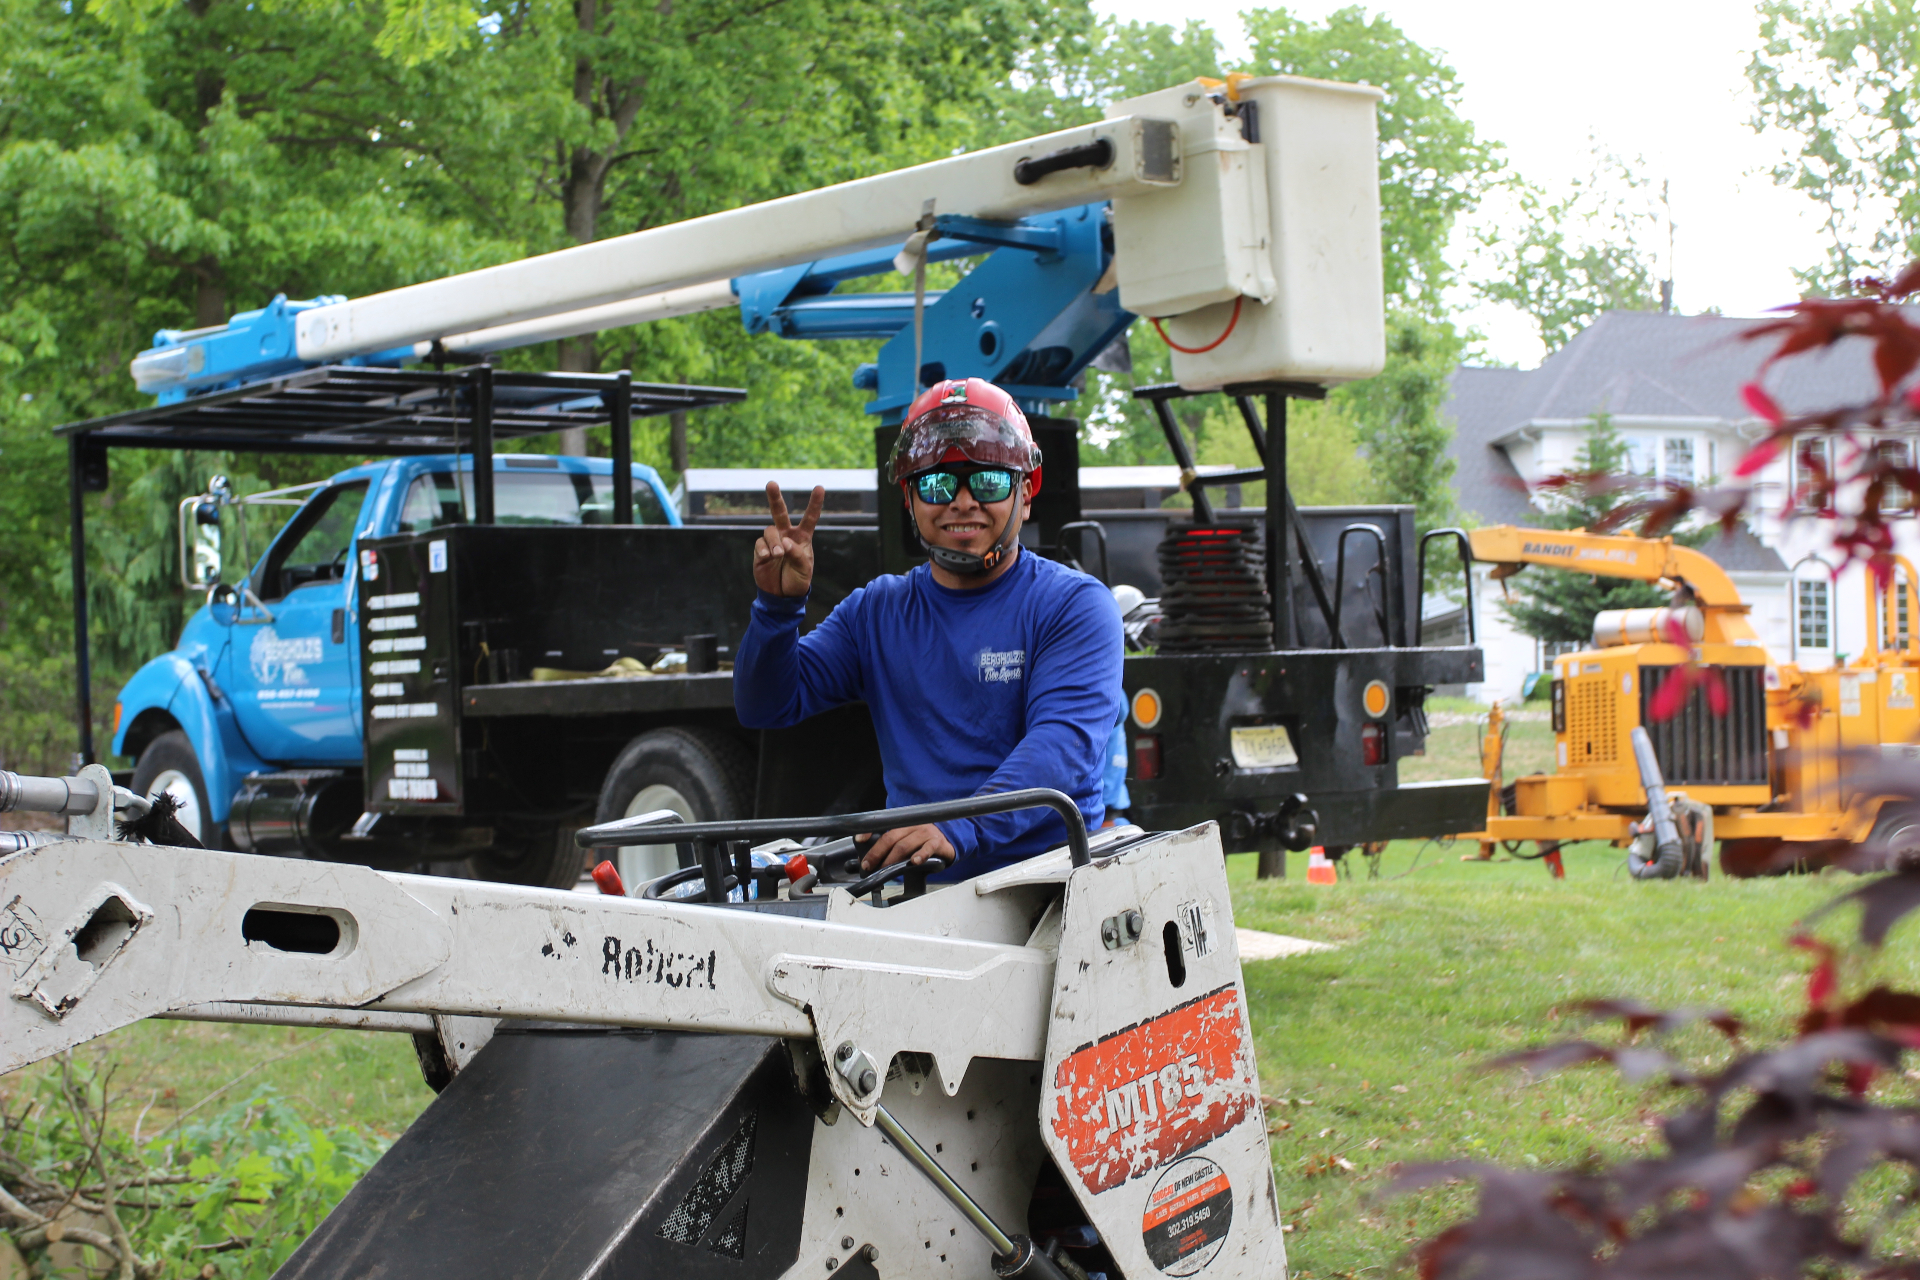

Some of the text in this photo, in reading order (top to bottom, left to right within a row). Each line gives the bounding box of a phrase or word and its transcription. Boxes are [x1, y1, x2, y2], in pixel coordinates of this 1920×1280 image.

[1523, 543, 1576, 558] BANDIT
[1104, 1052, 1201, 1135] MT85
[1152, 1183, 1174, 1204] BOBCAT
[1174, 1181, 1181, 1192] OF
[1181, 1173, 1194, 1188] NEW
[1194, 1164, 1213, 1182] CASTLE
[1167, 1206, 1211, 1238] 302.319.5450
